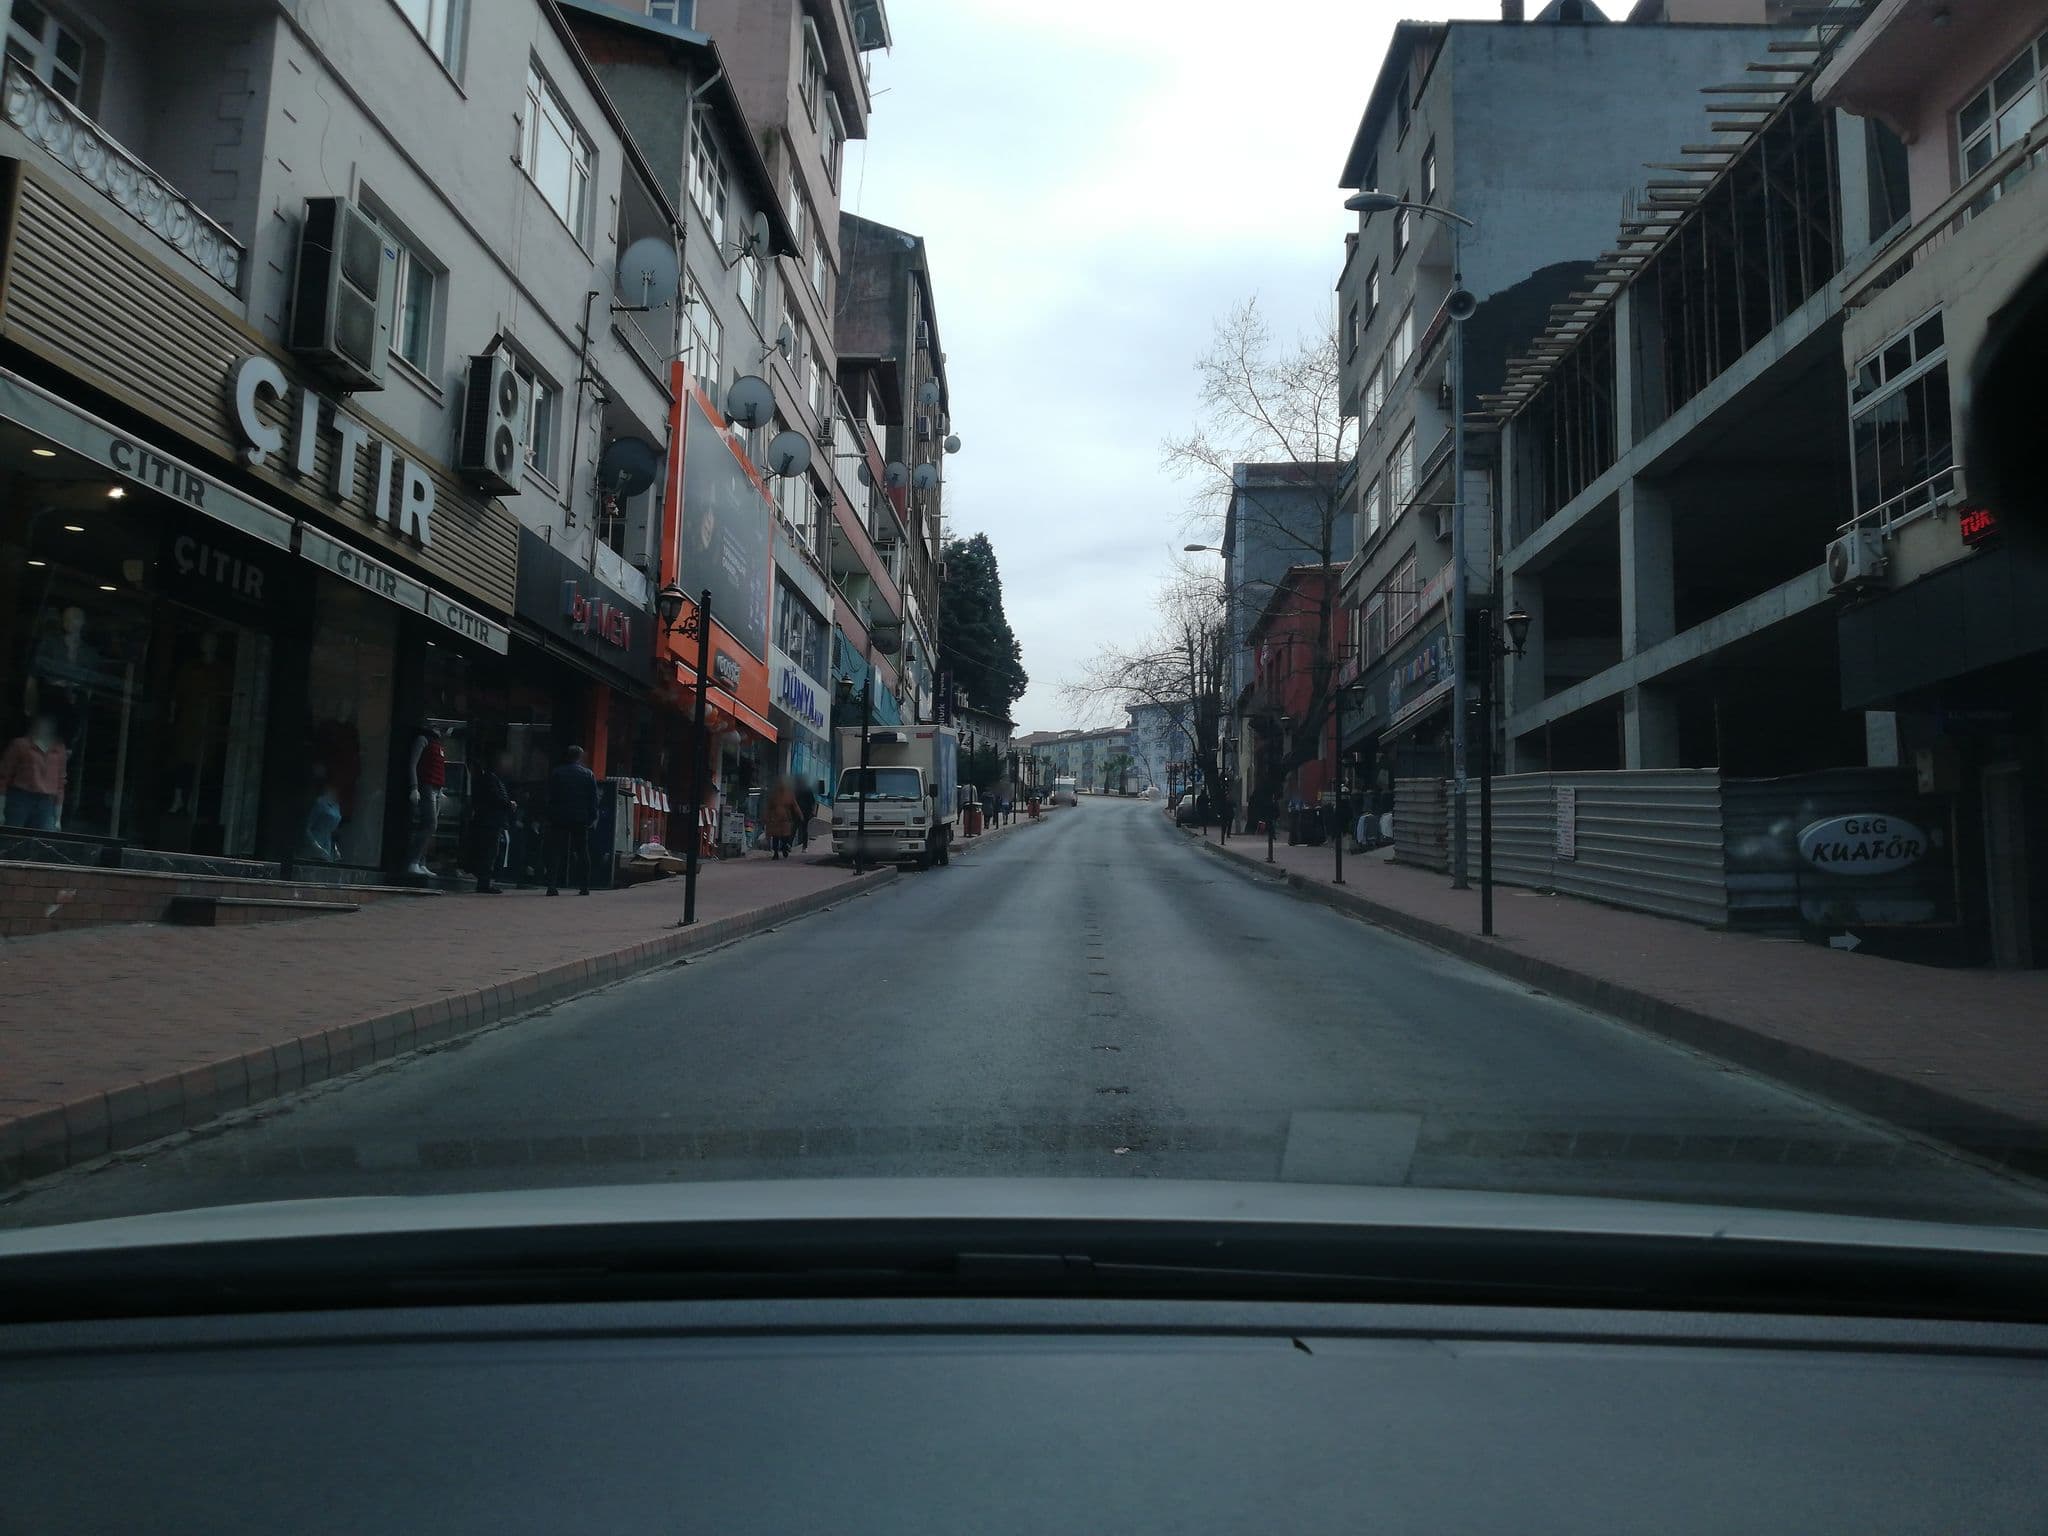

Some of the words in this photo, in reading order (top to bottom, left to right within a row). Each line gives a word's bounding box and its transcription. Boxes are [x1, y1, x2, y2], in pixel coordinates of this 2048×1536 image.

[234, 356, 435, 547] ÇITIR
[174, 535, 264, 600] ÇITIR
[591, 597, 631, 652] MEN
[782, 667, 816, 723] DÜNYA
[1811, 835, 1922, 862] KUAFÖR
[1844, 819, 1888, 835] G&G
